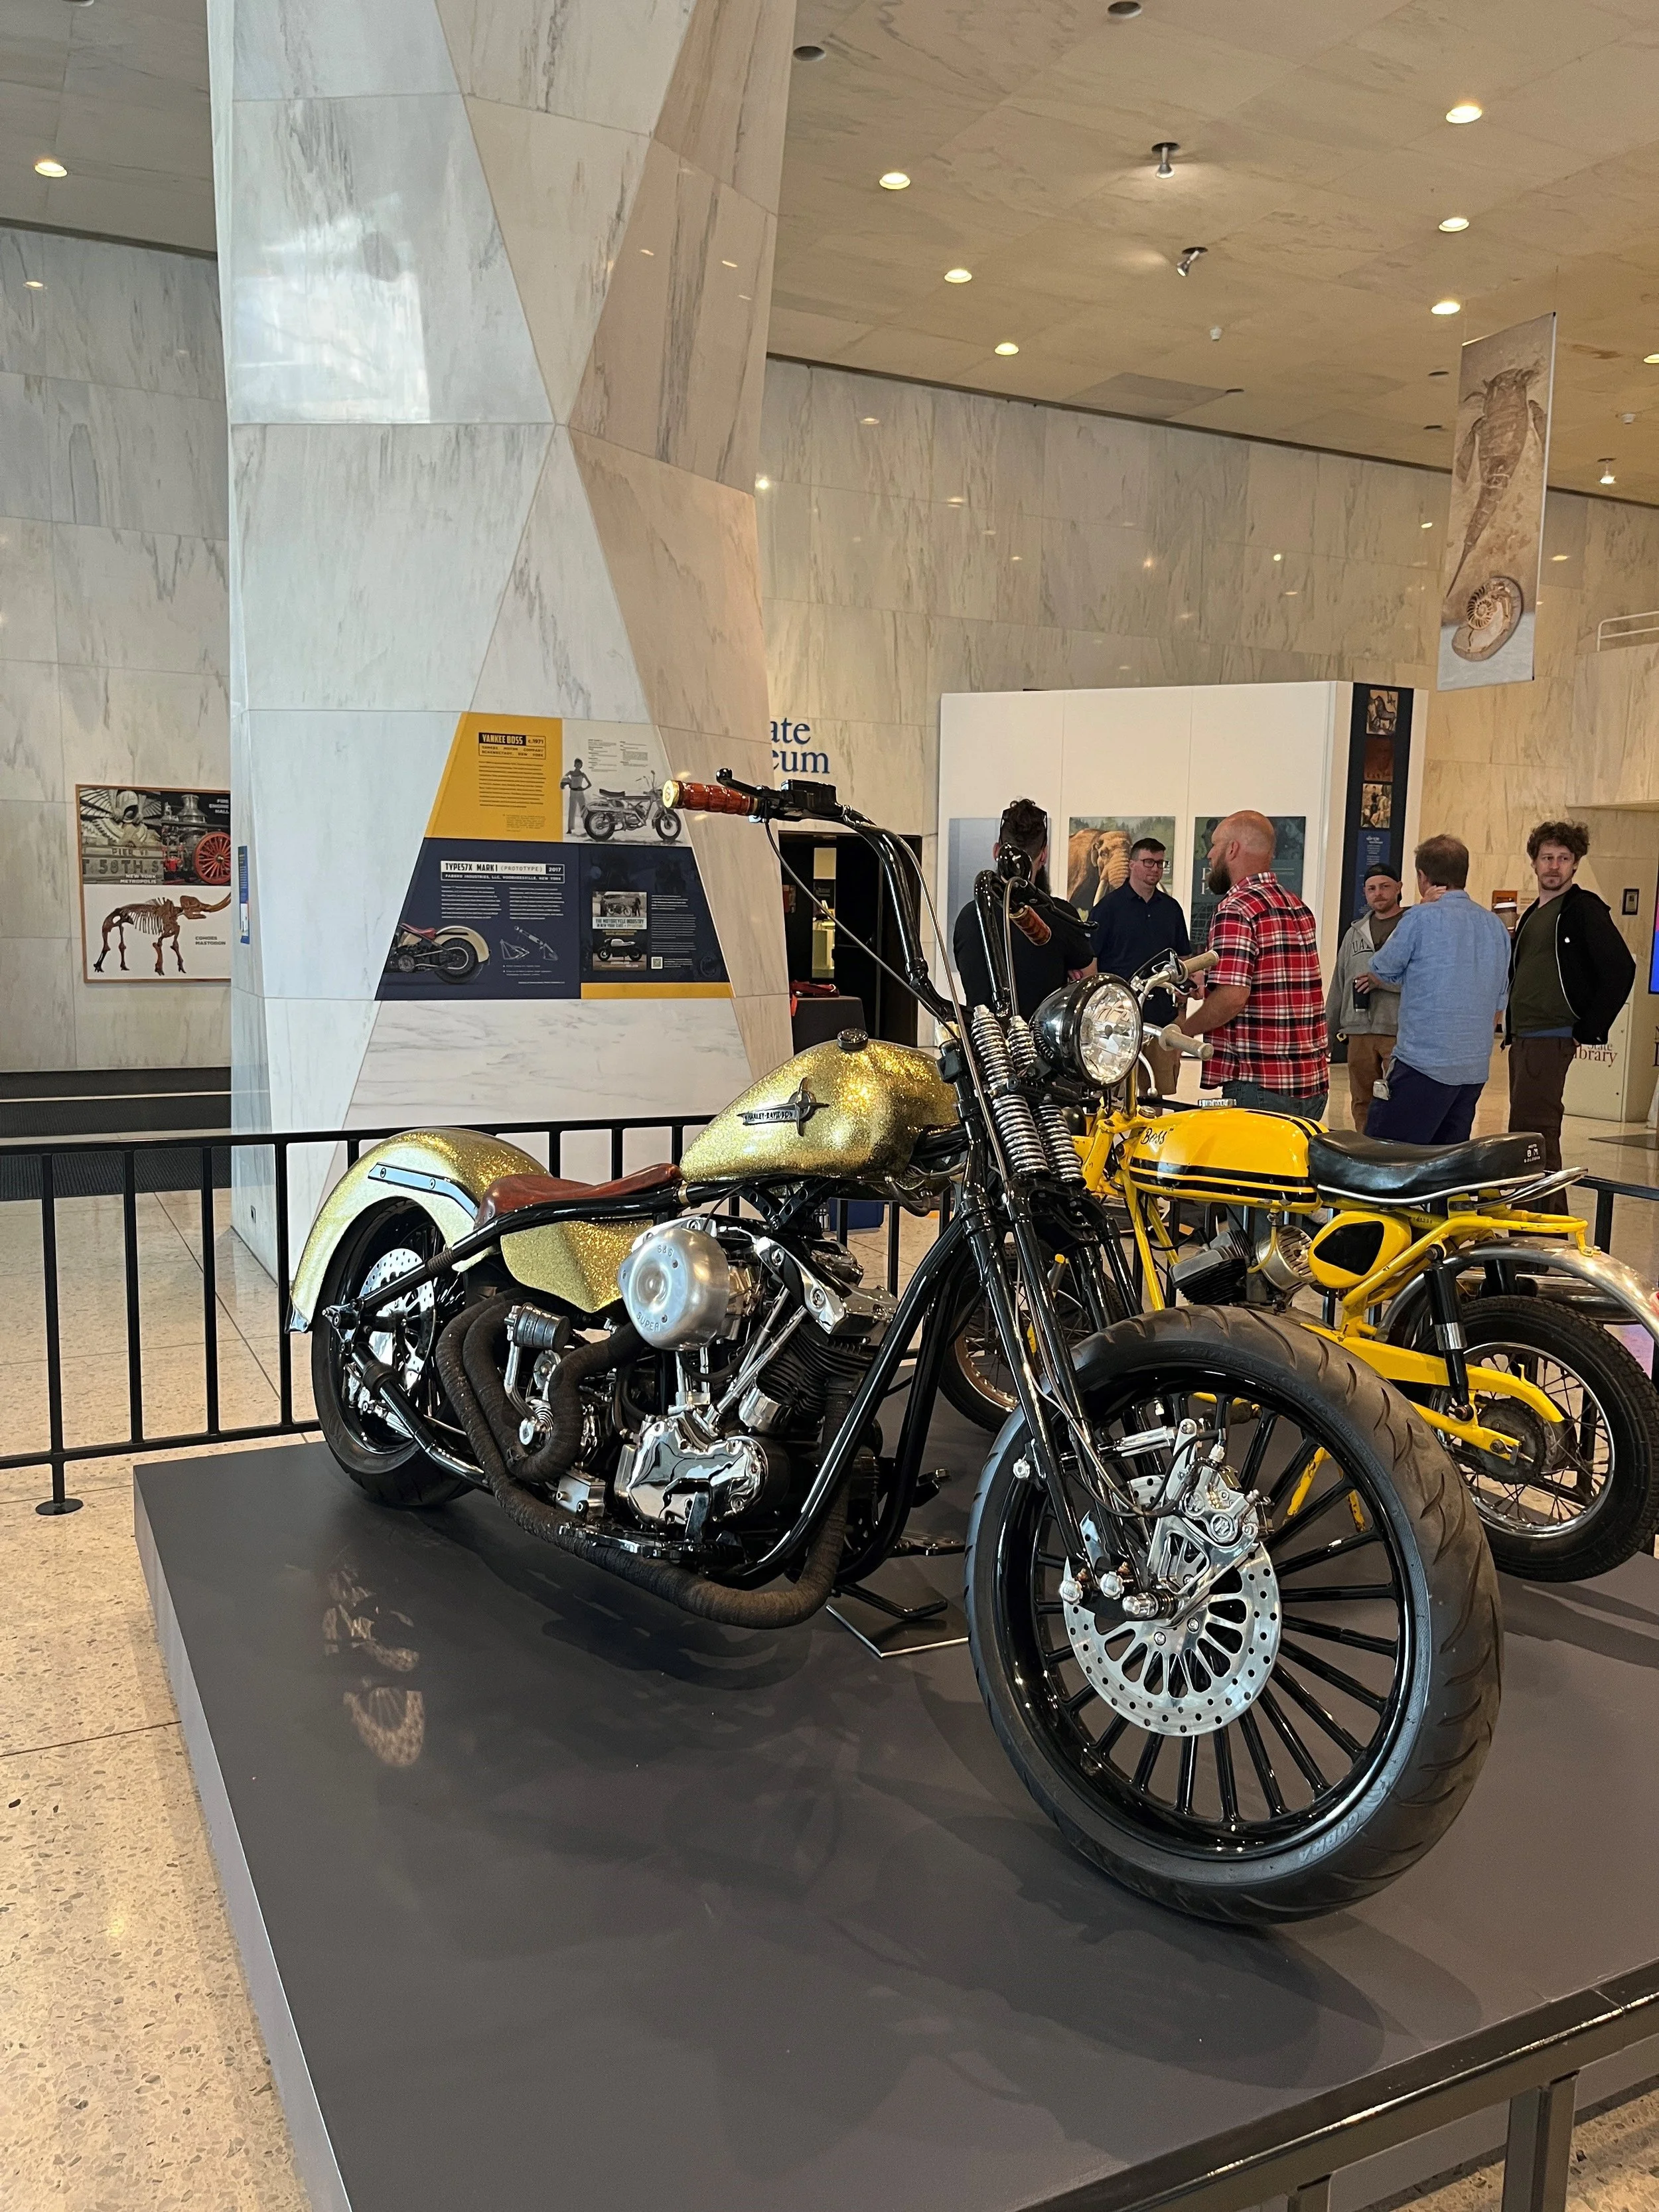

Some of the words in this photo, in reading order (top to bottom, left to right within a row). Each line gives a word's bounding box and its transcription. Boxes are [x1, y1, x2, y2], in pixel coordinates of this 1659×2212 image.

[482, 734, 506, 743] YANKEE
[506, 735, 523, 745] BOSS
[637, 1311, 660, 1331] SUPER
[1299, 1811, 1359, 1862] COBRA
